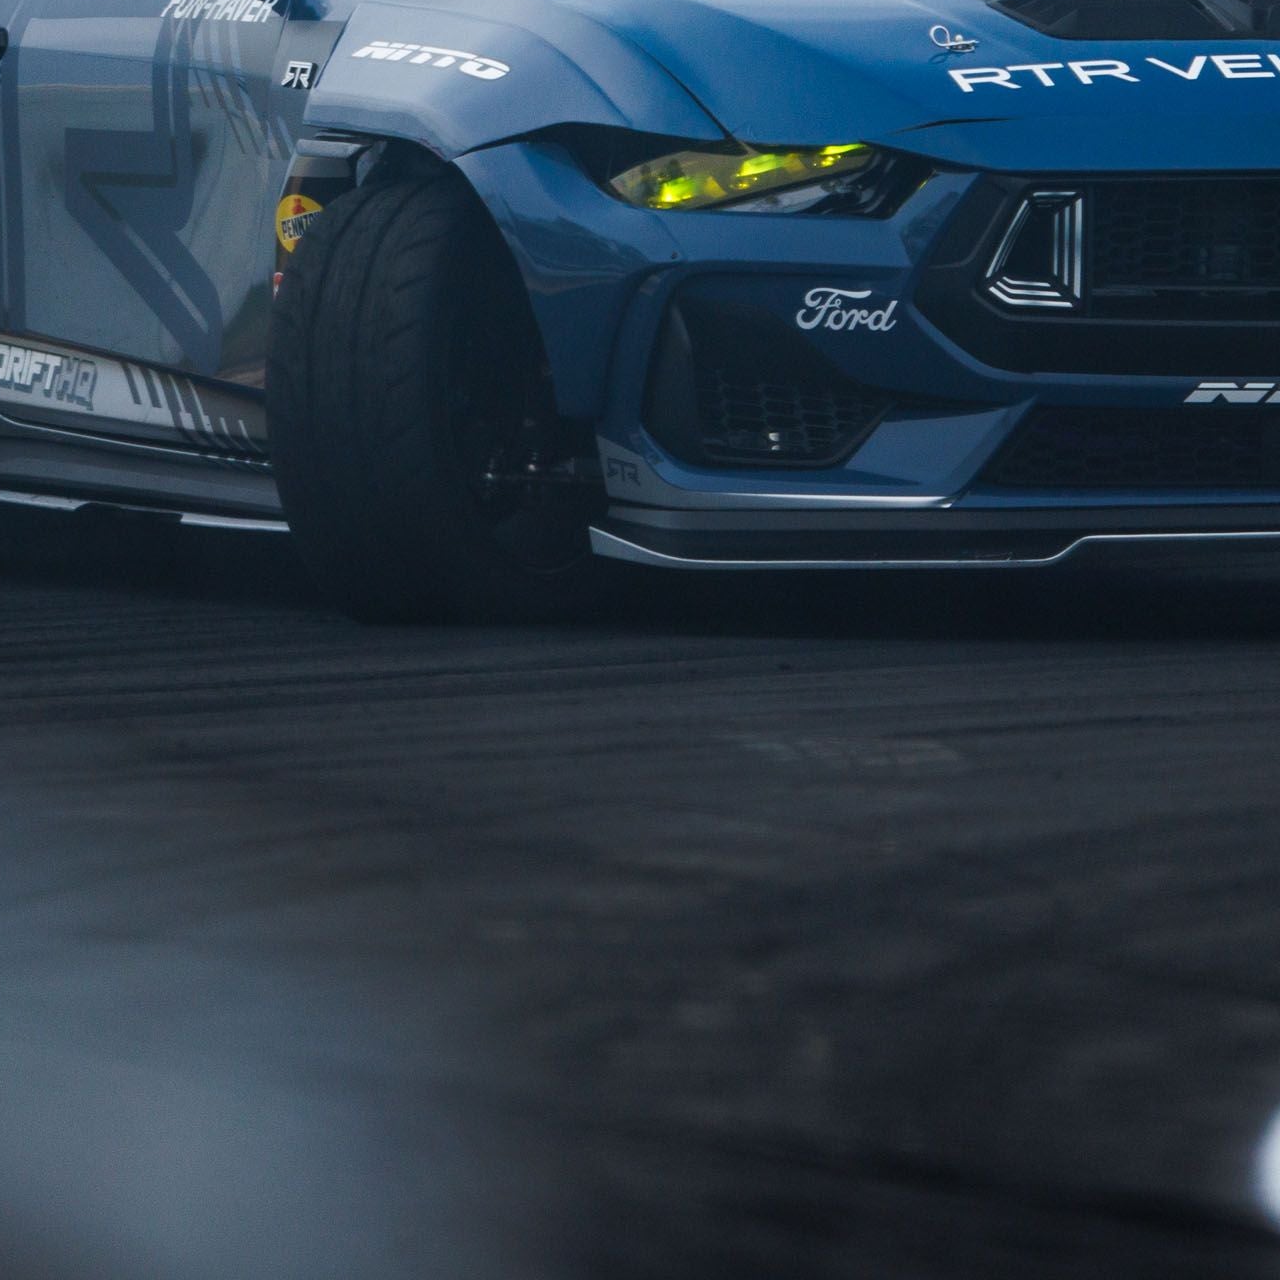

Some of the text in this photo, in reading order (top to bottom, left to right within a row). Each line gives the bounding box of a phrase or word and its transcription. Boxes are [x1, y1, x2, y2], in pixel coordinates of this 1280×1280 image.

[351, 40, 511, 81] NITTO
[949, 59, 1140, 94] RTR
[796, 287, 898, 332] Ford
